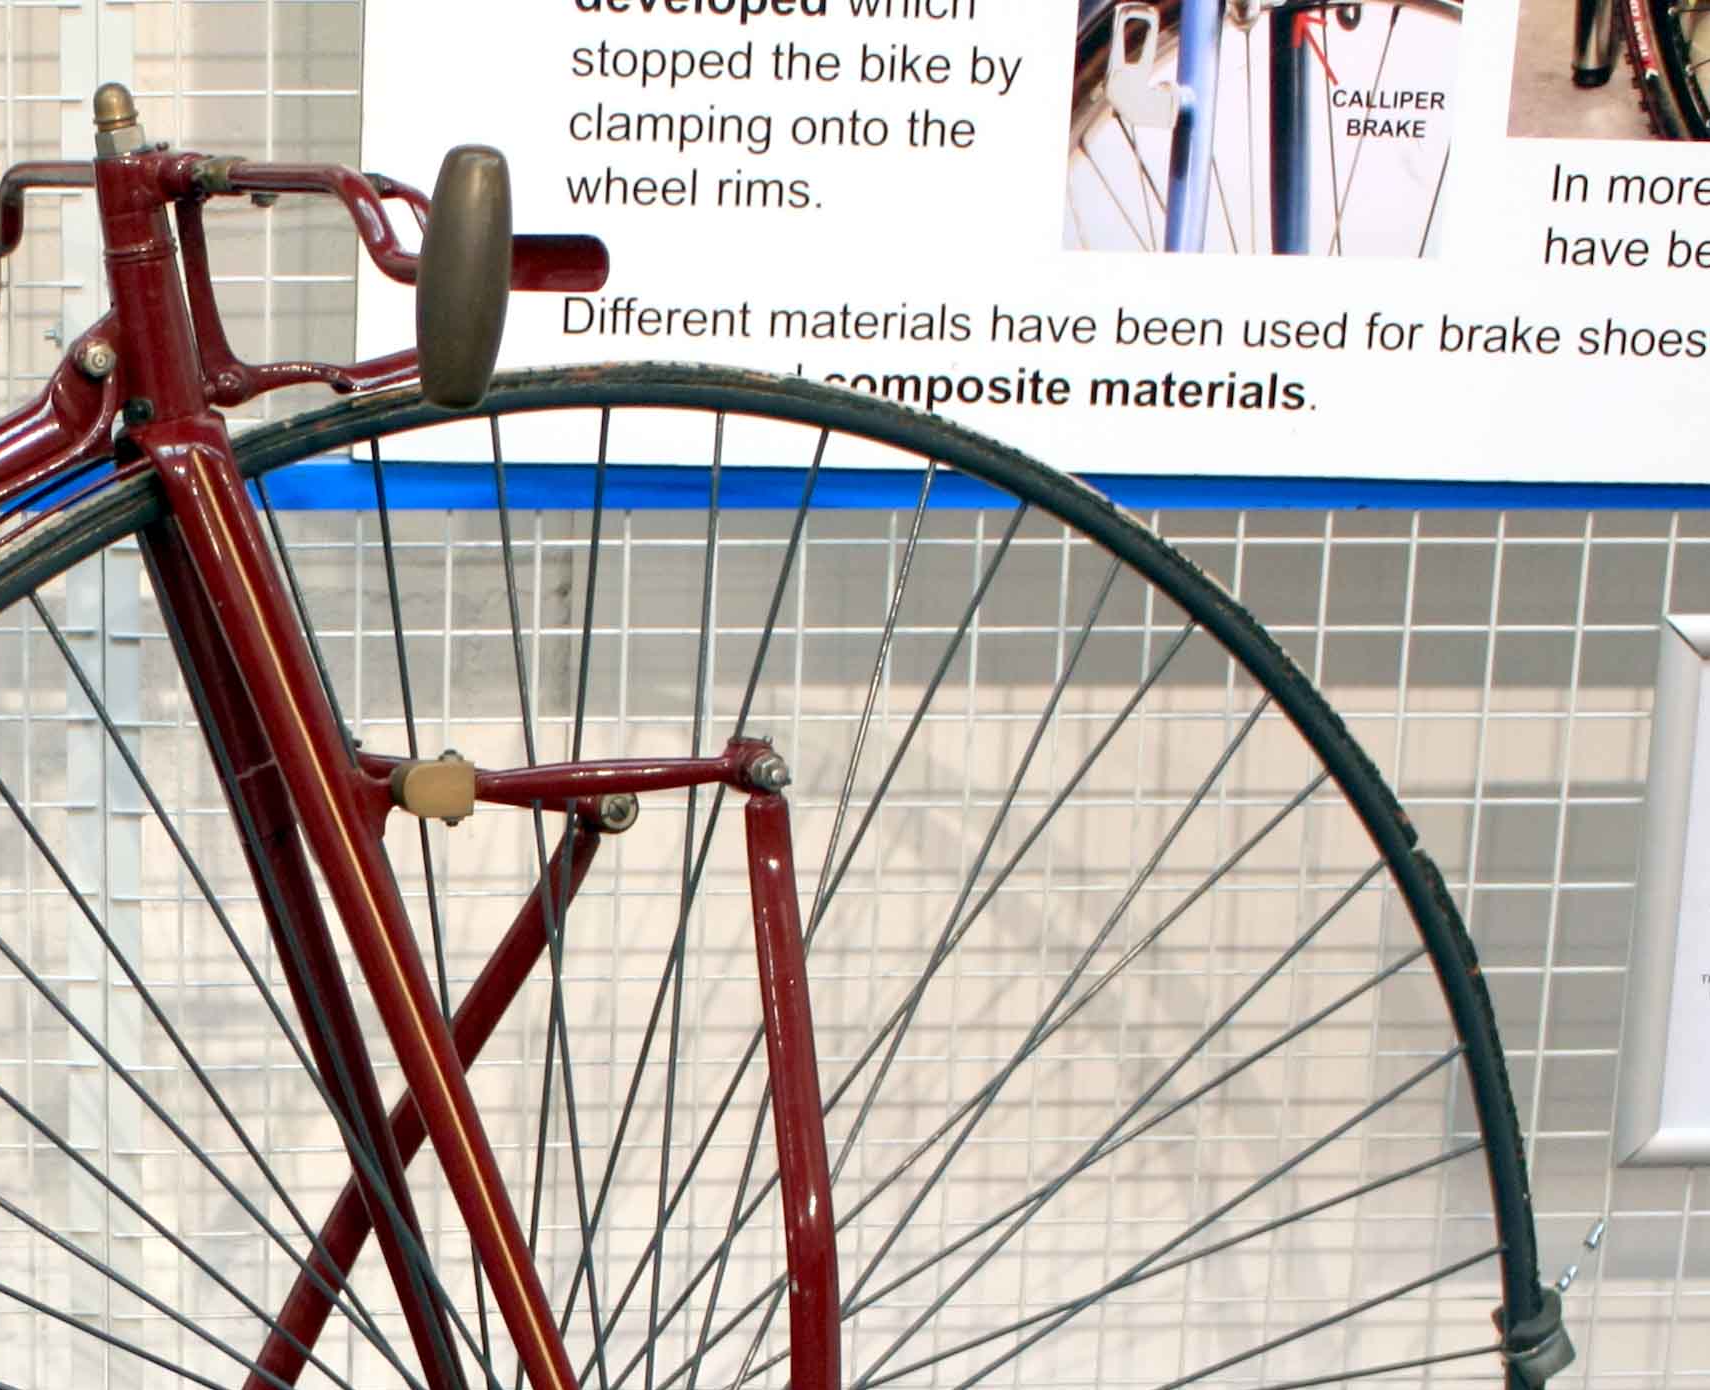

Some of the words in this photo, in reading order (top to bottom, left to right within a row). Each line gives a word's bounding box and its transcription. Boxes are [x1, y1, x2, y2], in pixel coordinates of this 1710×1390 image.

[571, 39, 753, 89] stopped
[772, 41, 842, 82] the
[860, 43, 952, 84] bike
[970, 45, 1023, 96] by
[1332, 89, 1446, 110] CALLIPER
[569, 102, 772, 155] clamping
[791, 109, 889, 147] onto
[907, 108, 976, 149] the
[1346, 118, 1426, 138] BRAKE
[566, 166, 698, 207] wheel
[717, 169, 822, 209] rims.
[1552, 163, 1589, 203] In
[1607, 175, 1710, 206] more
[1544, 226, 1650, 268] have
[563, 296, 751, 337] Different
[769, 303, 971, 342] materials
[991, 304, 1097, 344] have
[1115, 307, 1223, 347] been
[1243, 311, 1348, 350] used
[1366, 311, 1424, 351] for
[1439, 314, 1561, 355] brake
[1578, 318, 1707, 358] shoes
[1089, 371, 1317, 411] materials.
